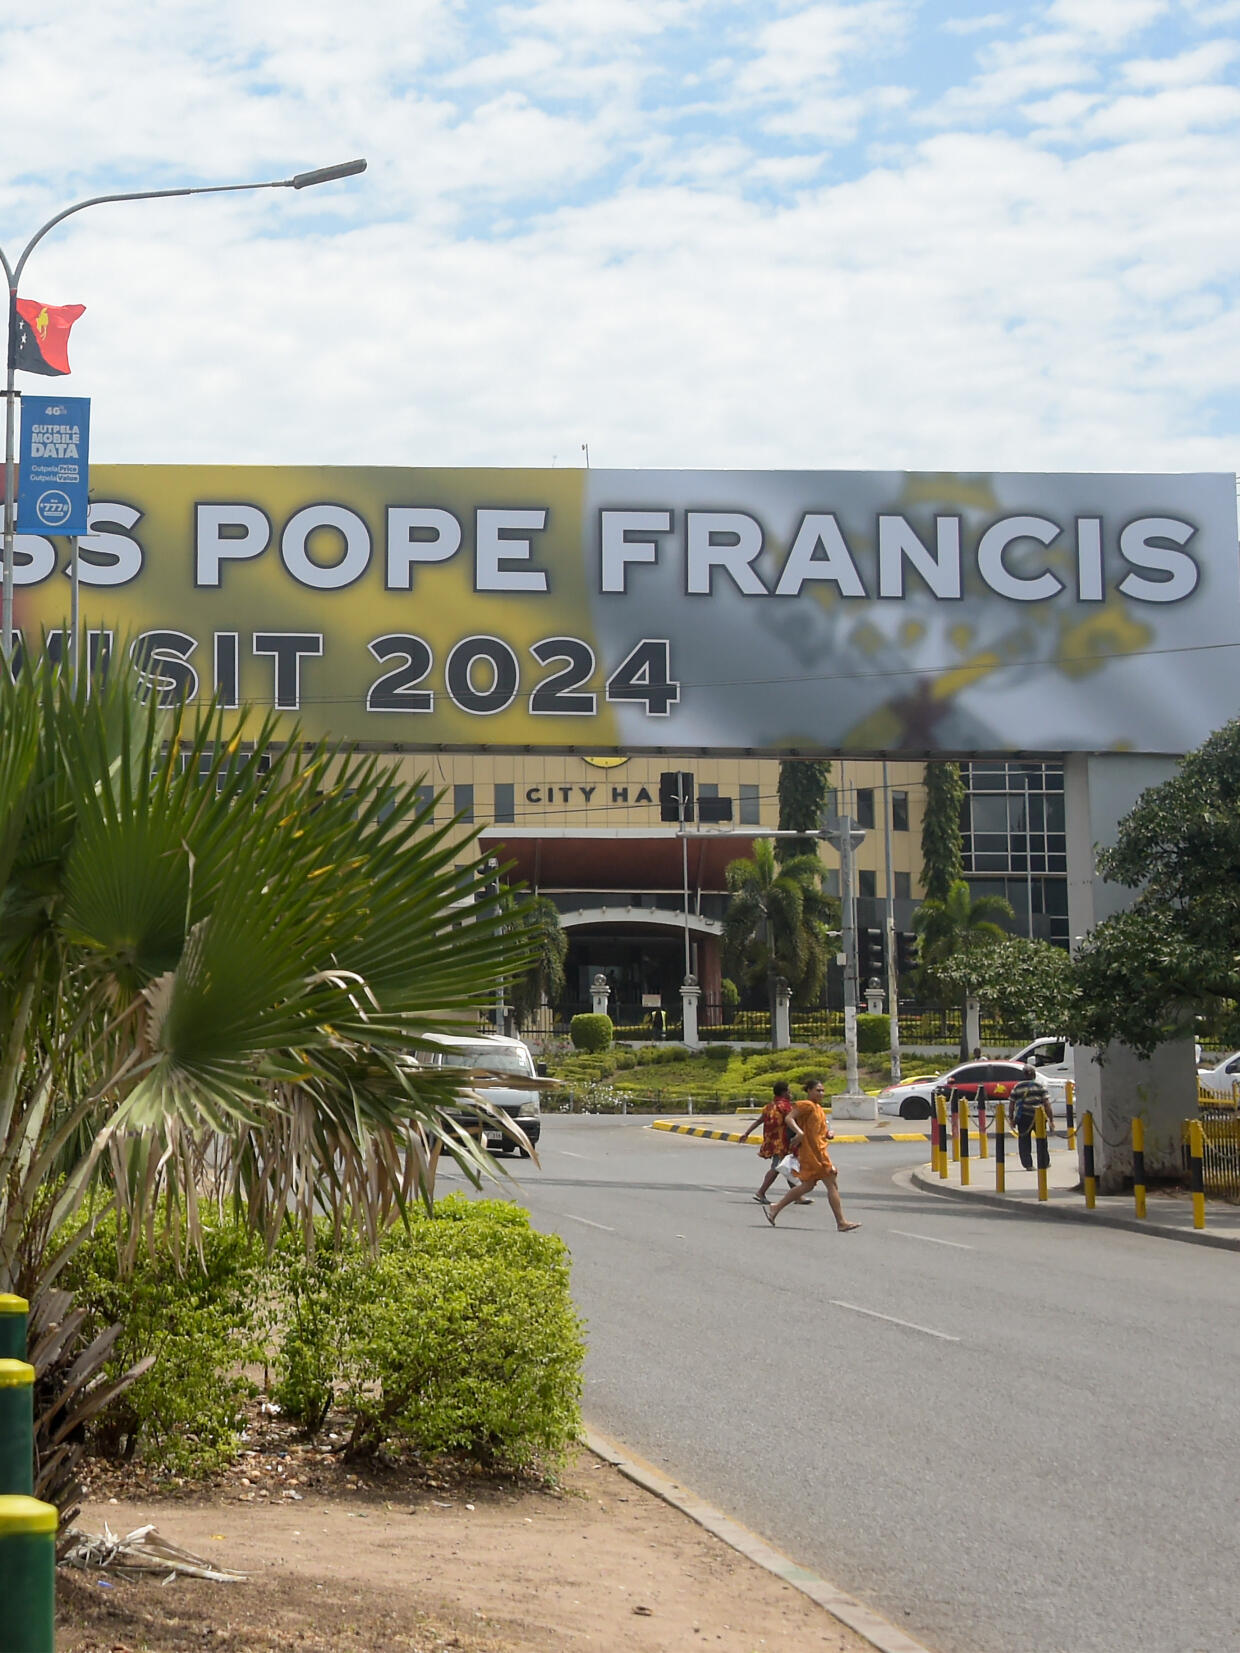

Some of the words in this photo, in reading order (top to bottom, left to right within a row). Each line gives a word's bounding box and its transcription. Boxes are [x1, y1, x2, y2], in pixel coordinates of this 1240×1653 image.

[31, 425, 79, 433] GUTPELA
[31, 433, 80, 444] MOBILE
[31, 444, 79, 458] DATA
[195, 503, 549, 592] POPE
[600, 510, 1199, 602] FRANCIS
[366, 633, 680, 716] 2024
[526, 787, 596, 803] CITY
[612, 787, 661, 803] HA
